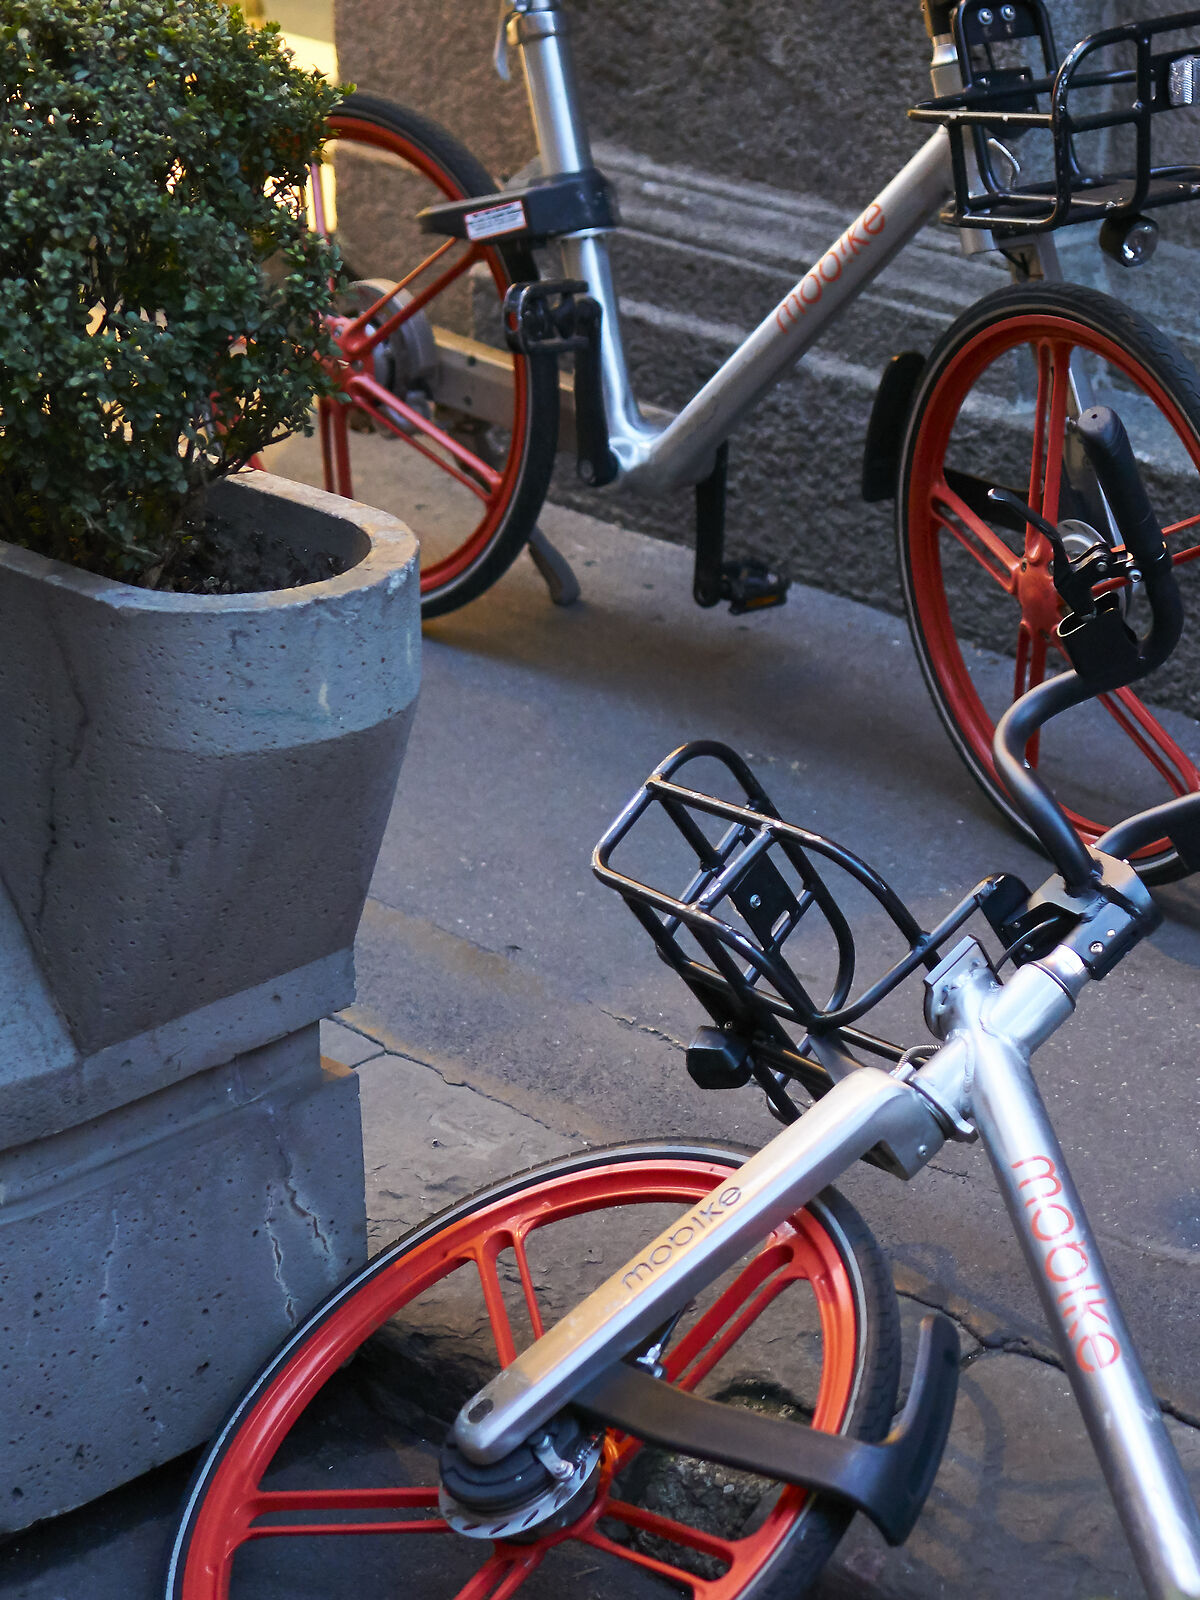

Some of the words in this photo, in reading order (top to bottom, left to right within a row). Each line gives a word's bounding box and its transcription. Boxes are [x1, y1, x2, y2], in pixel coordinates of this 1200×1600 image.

[776, 203, 885, 334] mobike
[621, 1186, 742, 1290] mobike
[1011, 1155, 1121, 1374] mobike
